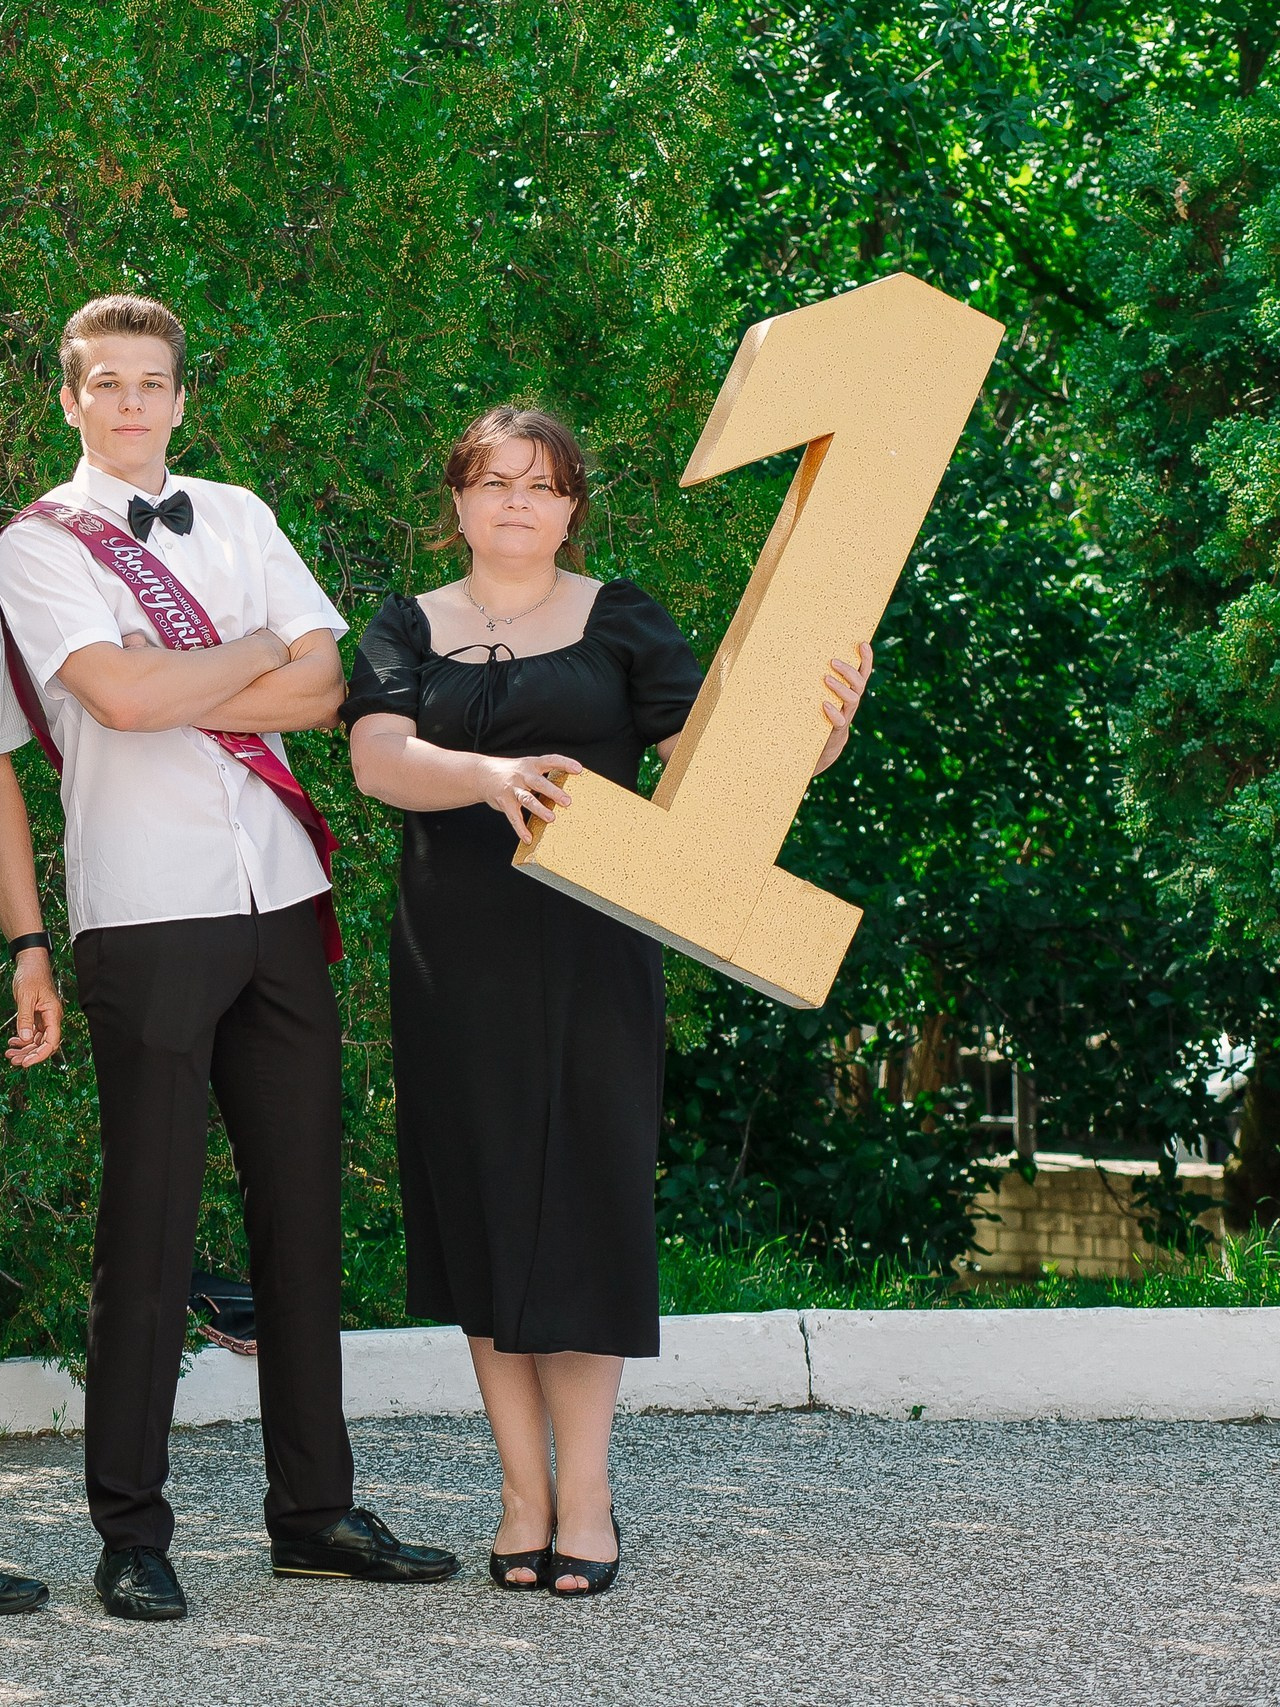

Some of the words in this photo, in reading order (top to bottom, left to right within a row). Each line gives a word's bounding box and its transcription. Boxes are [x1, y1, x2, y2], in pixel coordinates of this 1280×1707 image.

[111, 560, 141, 584] МАОУ
[154, 612, 176, 638] СОШ
[161, 575, 202, 625] Пономарев
[512, 272, 1005, 1009] 1
